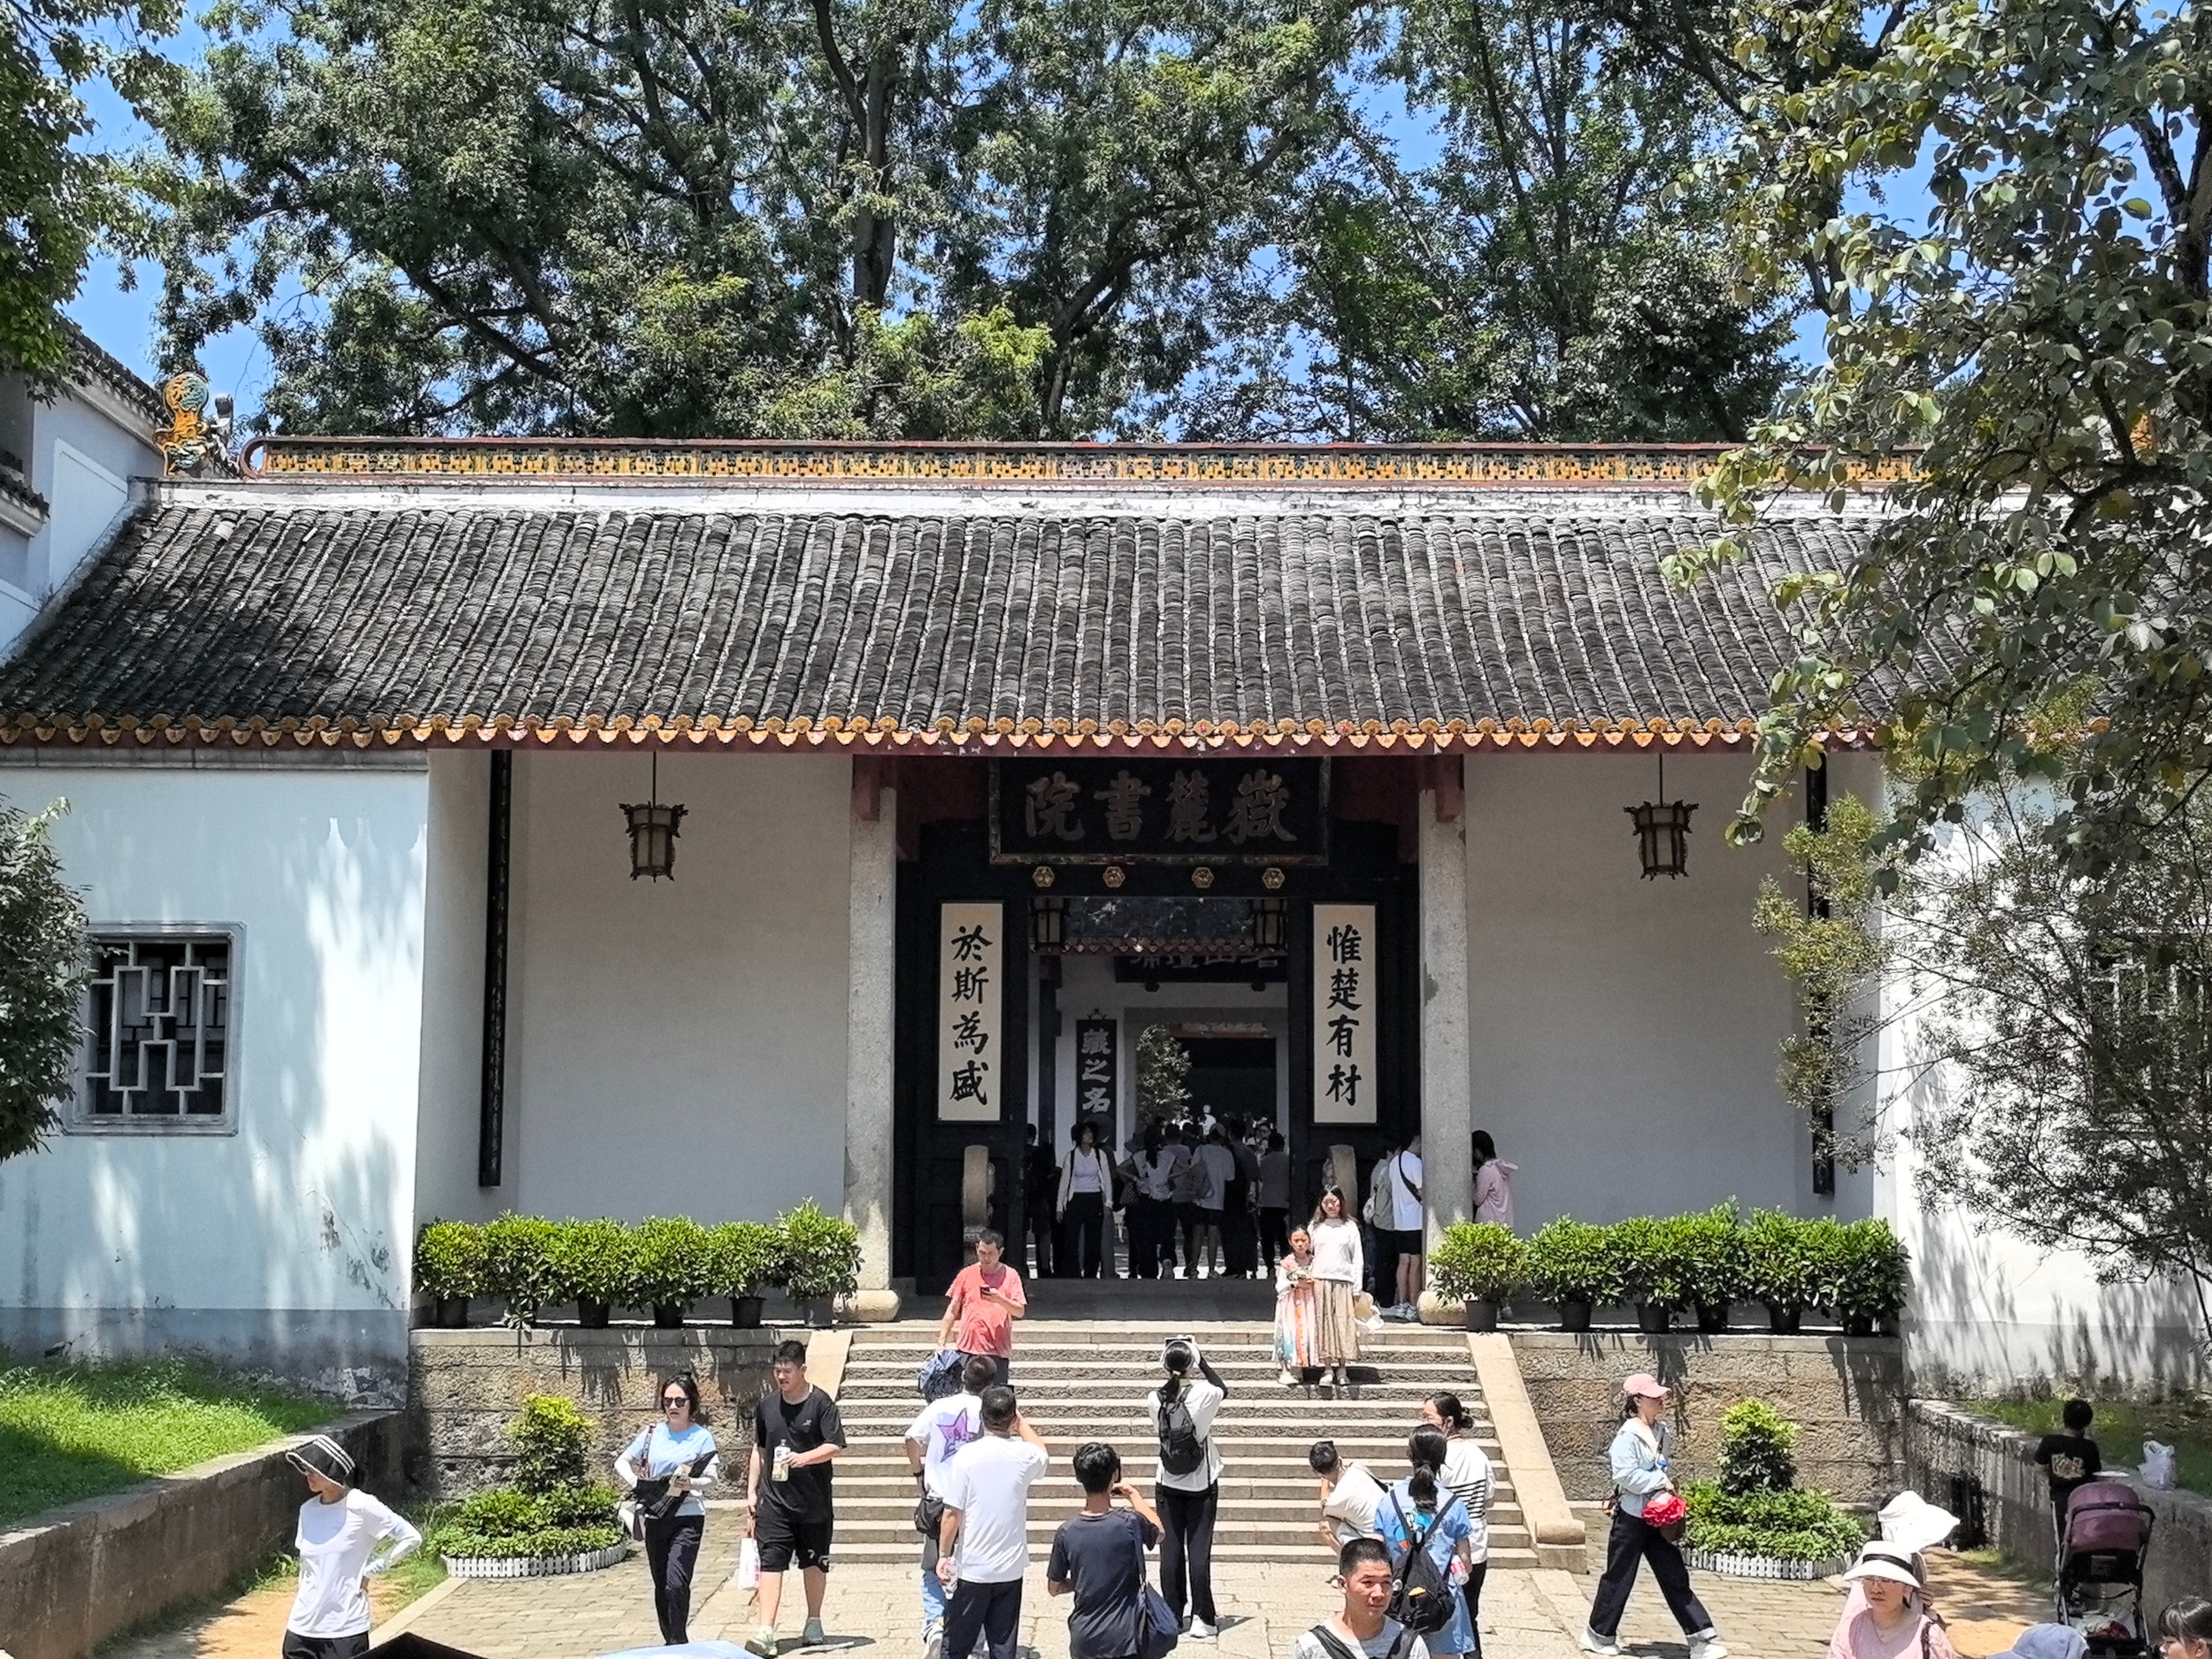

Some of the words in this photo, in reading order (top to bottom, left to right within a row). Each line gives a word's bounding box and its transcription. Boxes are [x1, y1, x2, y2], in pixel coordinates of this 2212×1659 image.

[949, 925, 994, 1106] 於斯為盛
[1080, 1028, 1112, 1114] 藏之名
[1325, 924, 1363, 1107] 惟楚有材
